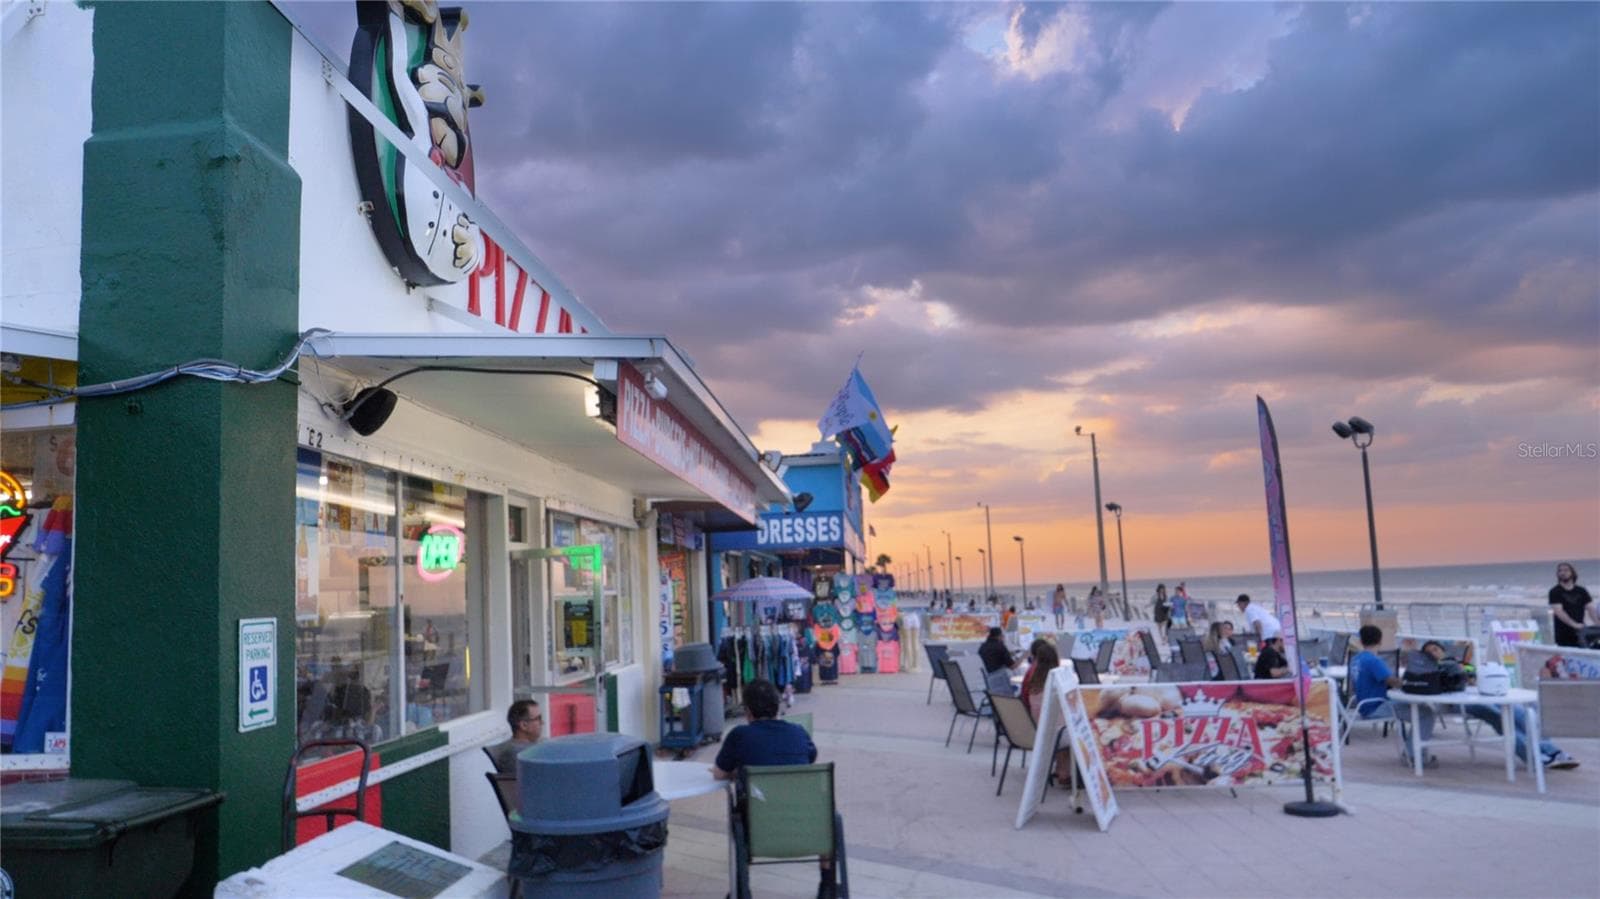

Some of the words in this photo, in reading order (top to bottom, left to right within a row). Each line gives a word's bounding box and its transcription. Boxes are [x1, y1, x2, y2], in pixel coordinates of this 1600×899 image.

[757, 516, 841, 544] DRESSES
[422, 534, 459, 570] OPEN
[243, 631, 272, 645] RESERVED
[245, 647, 271, 659] PARKING
[1143, 716, 1264, 761] PIZZA
[1145, 743, 1254, 776] King
